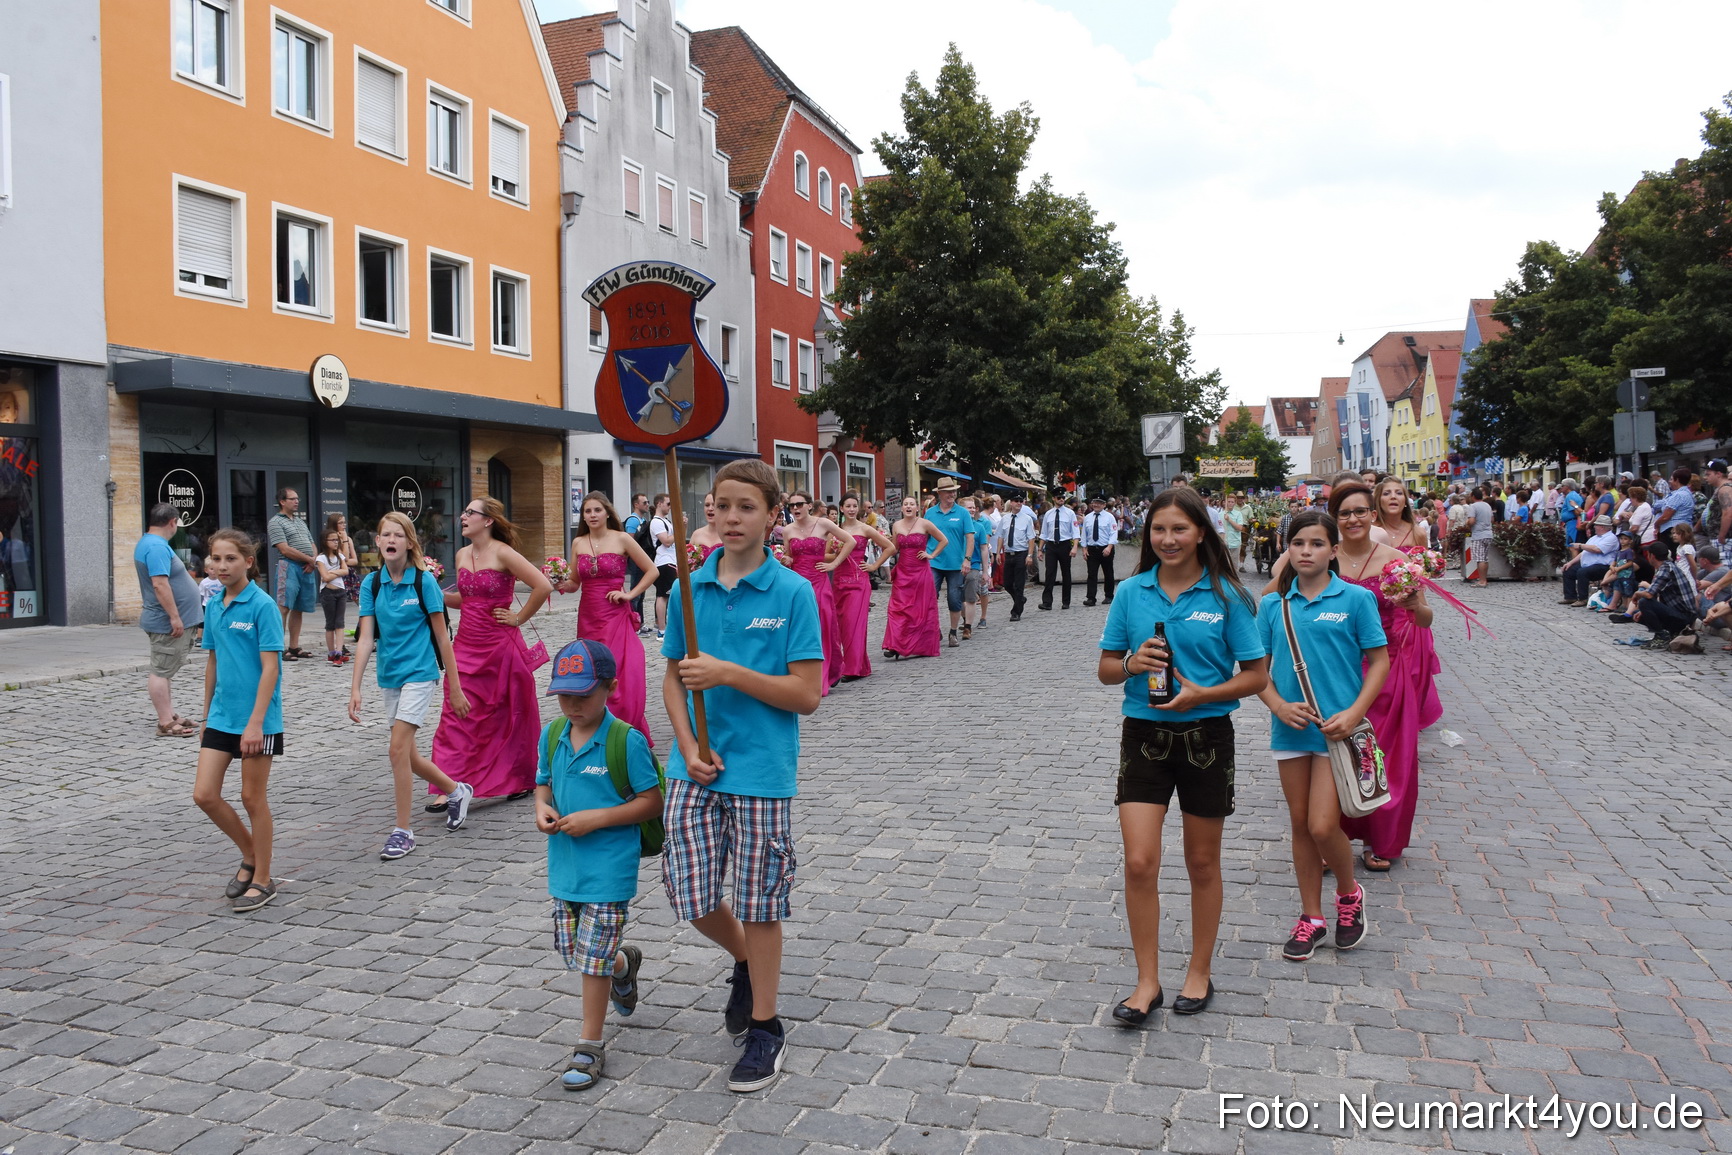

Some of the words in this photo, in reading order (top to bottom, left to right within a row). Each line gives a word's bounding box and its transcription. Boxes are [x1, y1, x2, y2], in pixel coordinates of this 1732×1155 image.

[588, 272, 621, 303] FFW
[625, 264, 705, 296] Günching
[627, 302, 667, 320] 1891
[630, 322, 671, 341] 2016
[321, 367, 343, 380] Dianas
[321, 380, 343, 391] Floristik
[168, 484, 195, 496] Dianas
[397, 488, 416, 499] Dianas
[169, 497, 195, 508] Floristik
[398, 498, 416, 508] Floristik
[557, 654, 585, 676] 86
